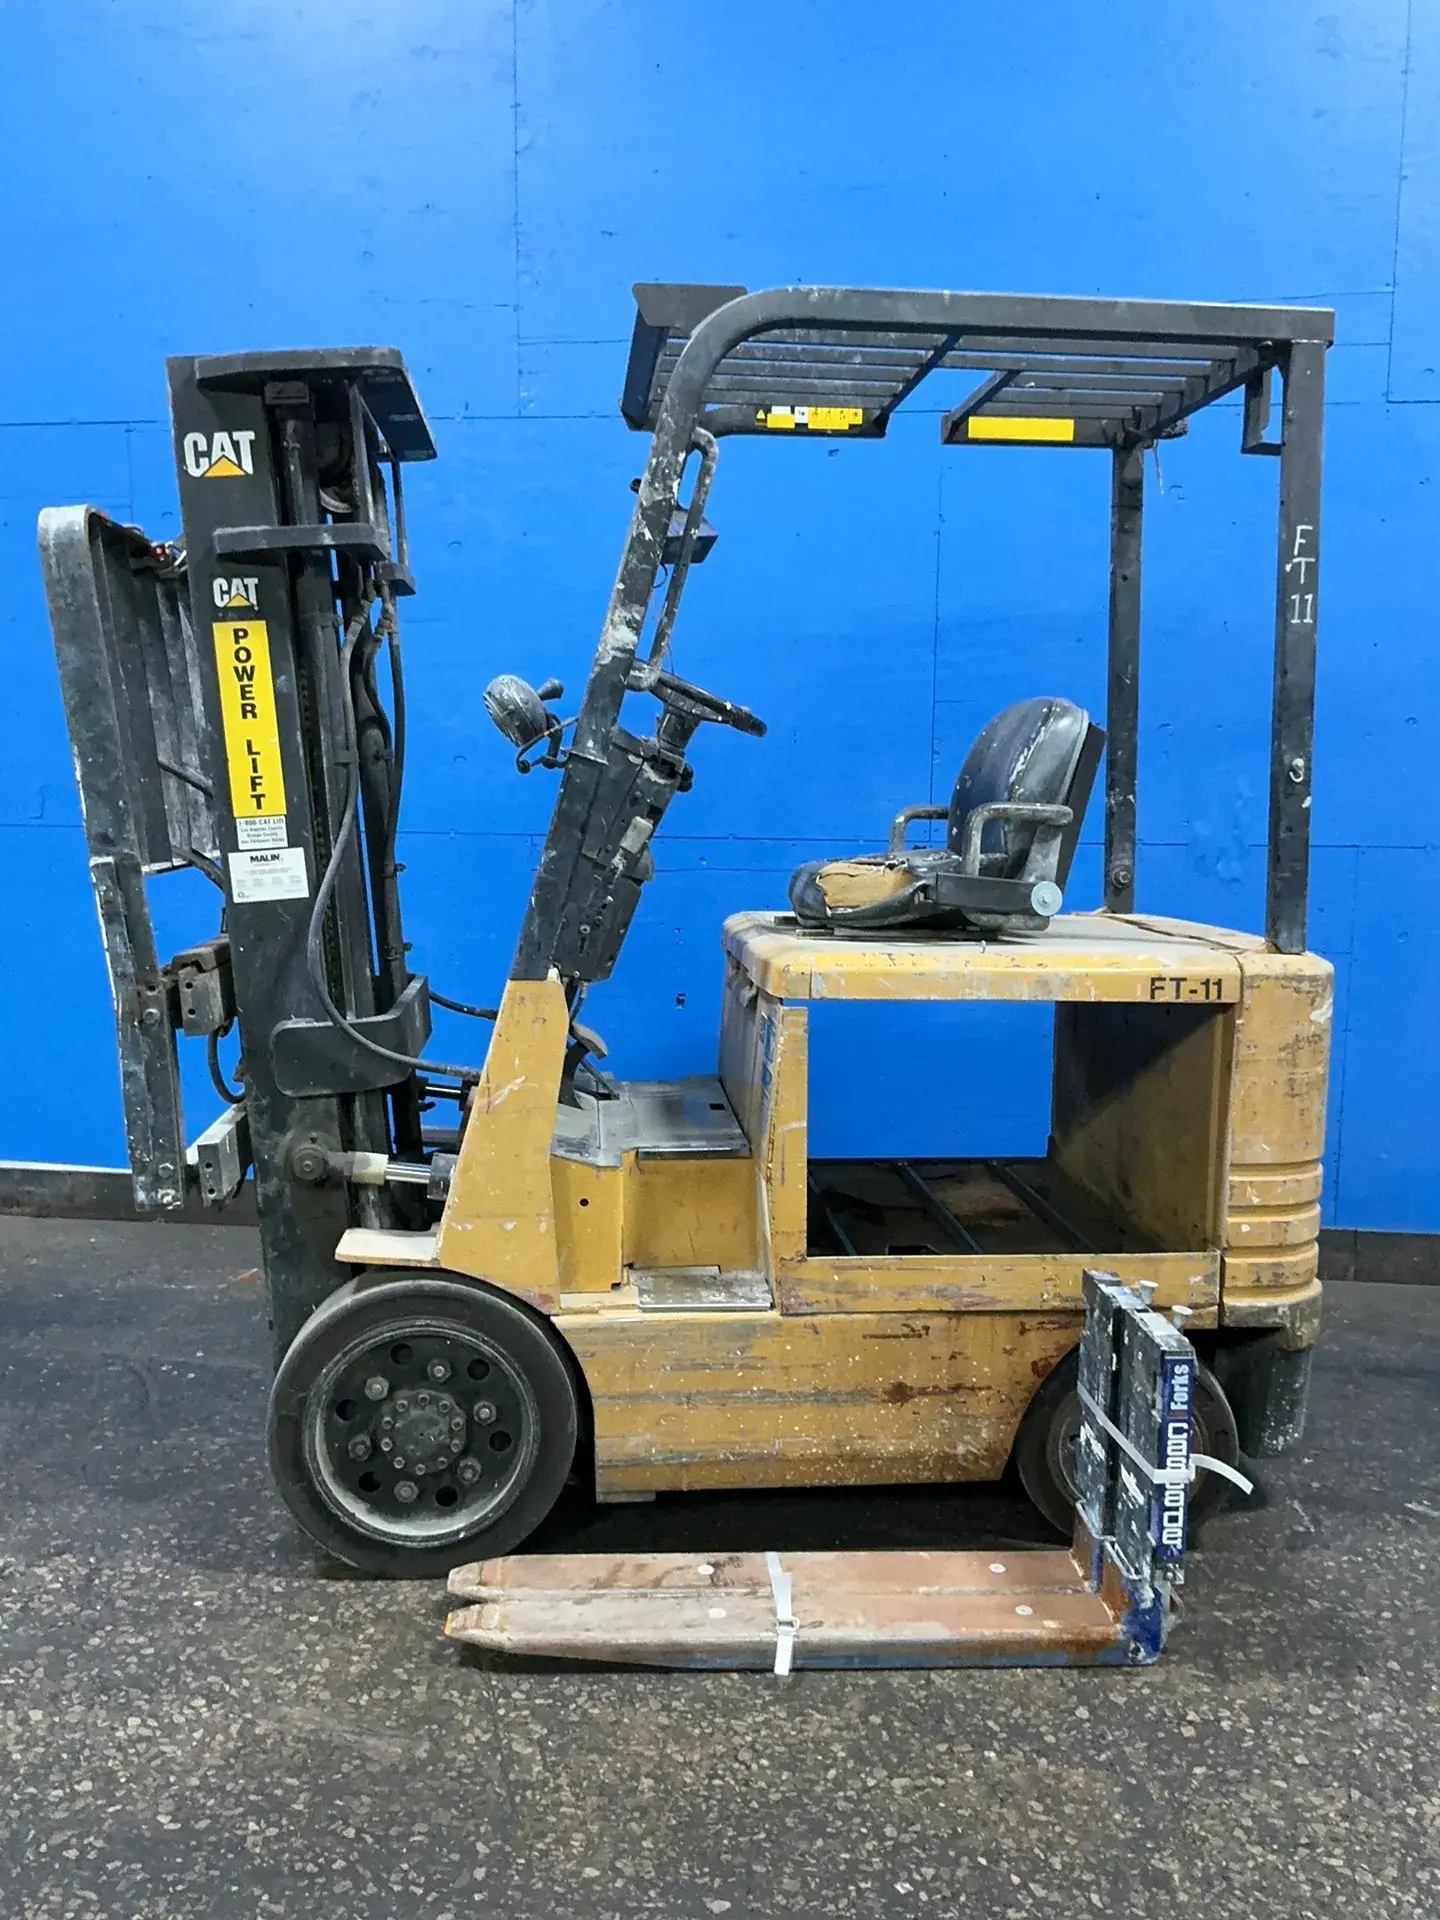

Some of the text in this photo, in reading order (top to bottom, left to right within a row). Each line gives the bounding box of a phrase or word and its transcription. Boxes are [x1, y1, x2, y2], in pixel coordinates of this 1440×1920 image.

[183, 430, 256, 478] CAT
[212, 577, 259, 608] CAT
[232, 628, 258, 719] POWER
[246, 739, 267, 811] LIFT
[250, 853, 280, 863] MALIN
[1150, 977, 1223, 1000] FT-11
[1169, 1364, 1190, 1411] Forks
